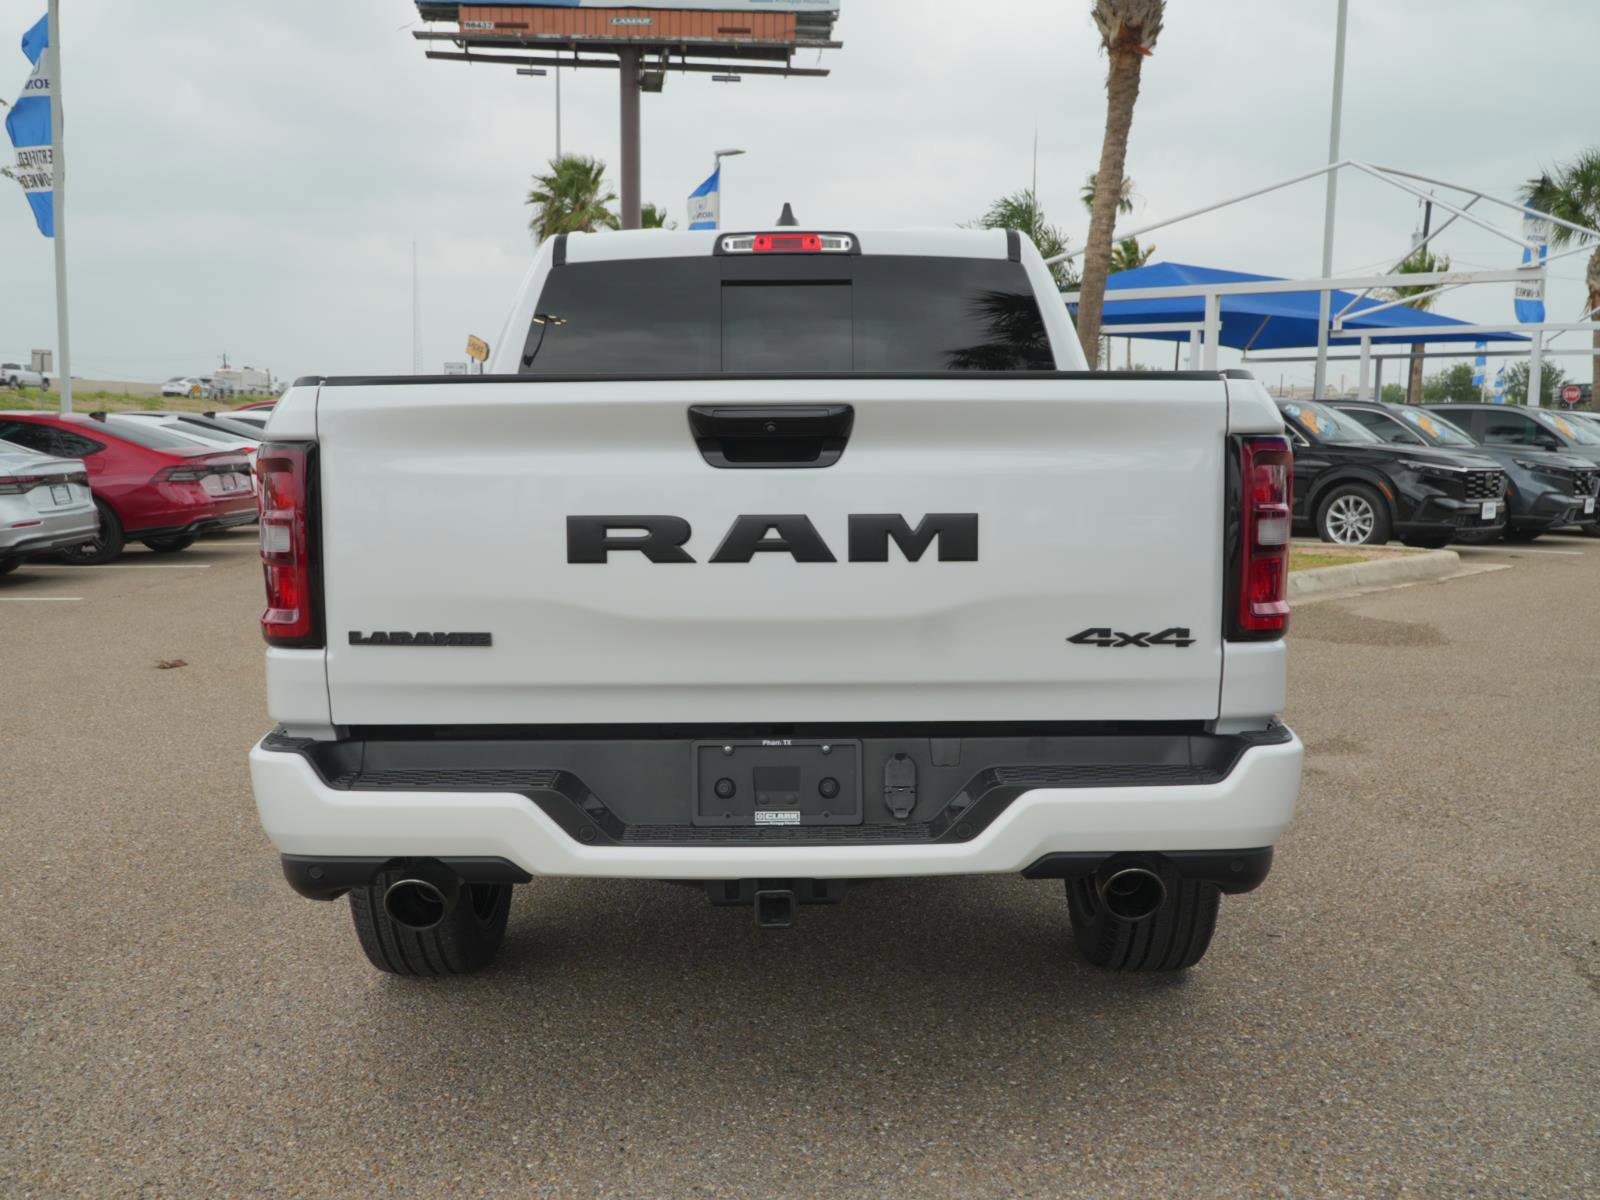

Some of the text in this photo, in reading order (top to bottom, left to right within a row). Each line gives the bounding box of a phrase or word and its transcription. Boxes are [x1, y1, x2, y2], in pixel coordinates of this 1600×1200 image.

[612, 17, 652, 25] LAMAR
[566, 513, 979, 564] RAM
[348, 631, 492, 647] LARAMIE
[1065, 627, 1197, 647] 4x4
